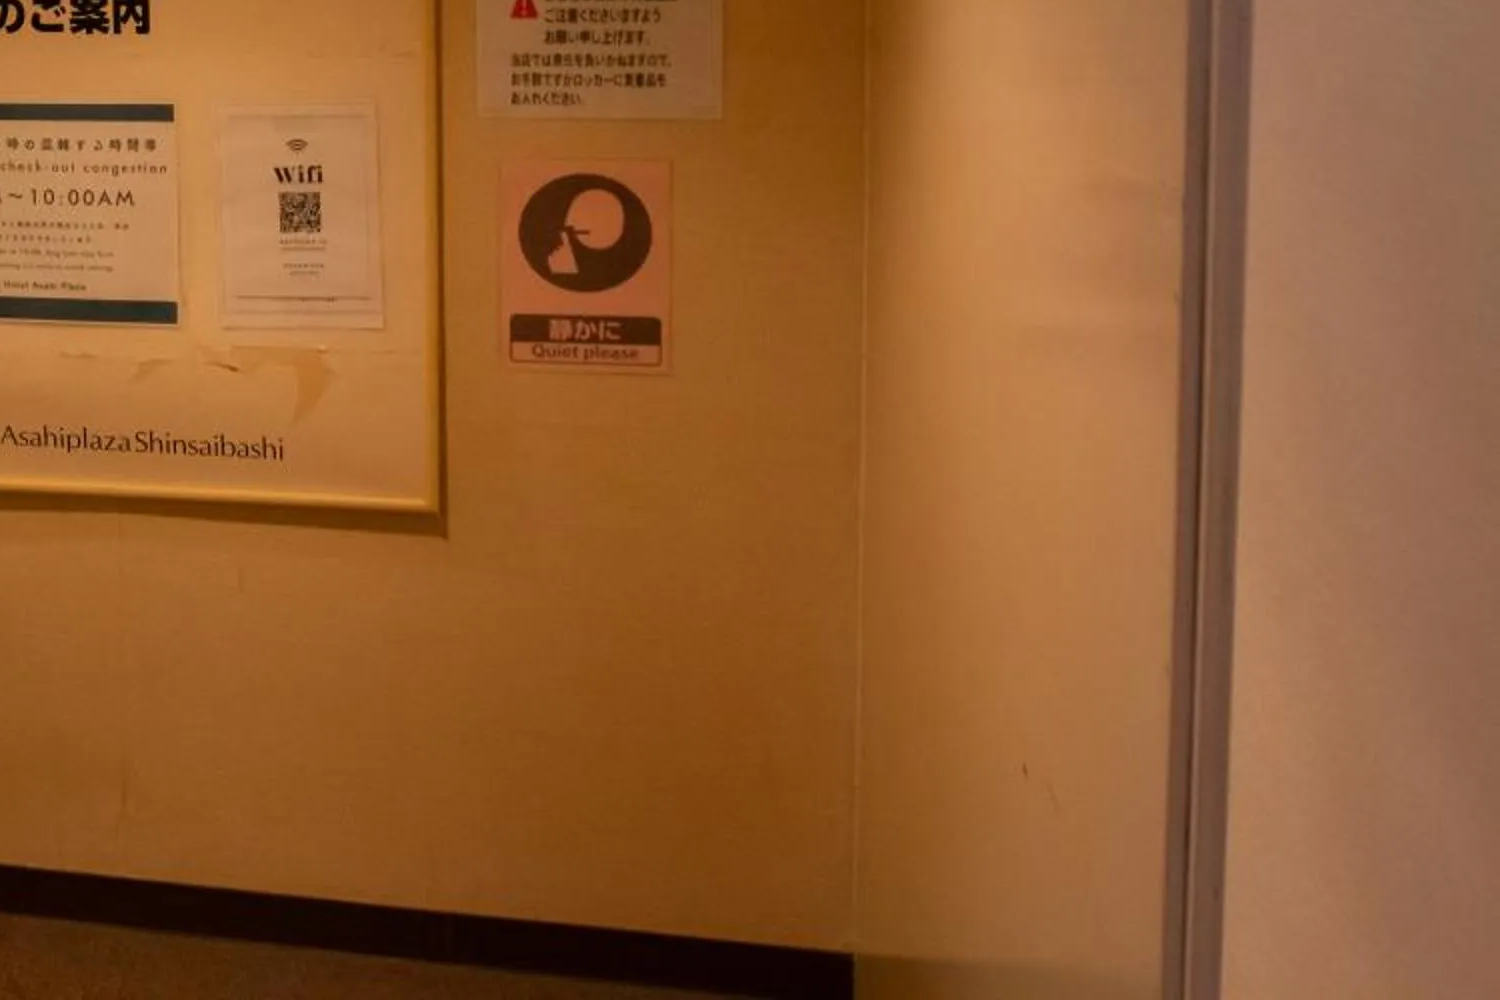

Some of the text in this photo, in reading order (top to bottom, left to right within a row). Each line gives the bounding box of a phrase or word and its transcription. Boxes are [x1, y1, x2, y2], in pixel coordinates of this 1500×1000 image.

[83, 161, 169, 176] congestion
[273, 164, 324, 184] Wifi
[548, 318, 621, 340] 静かに
[532, 343, 639, 362] Quiet please
[135, 430, 284, 462] Shinsaibashi
